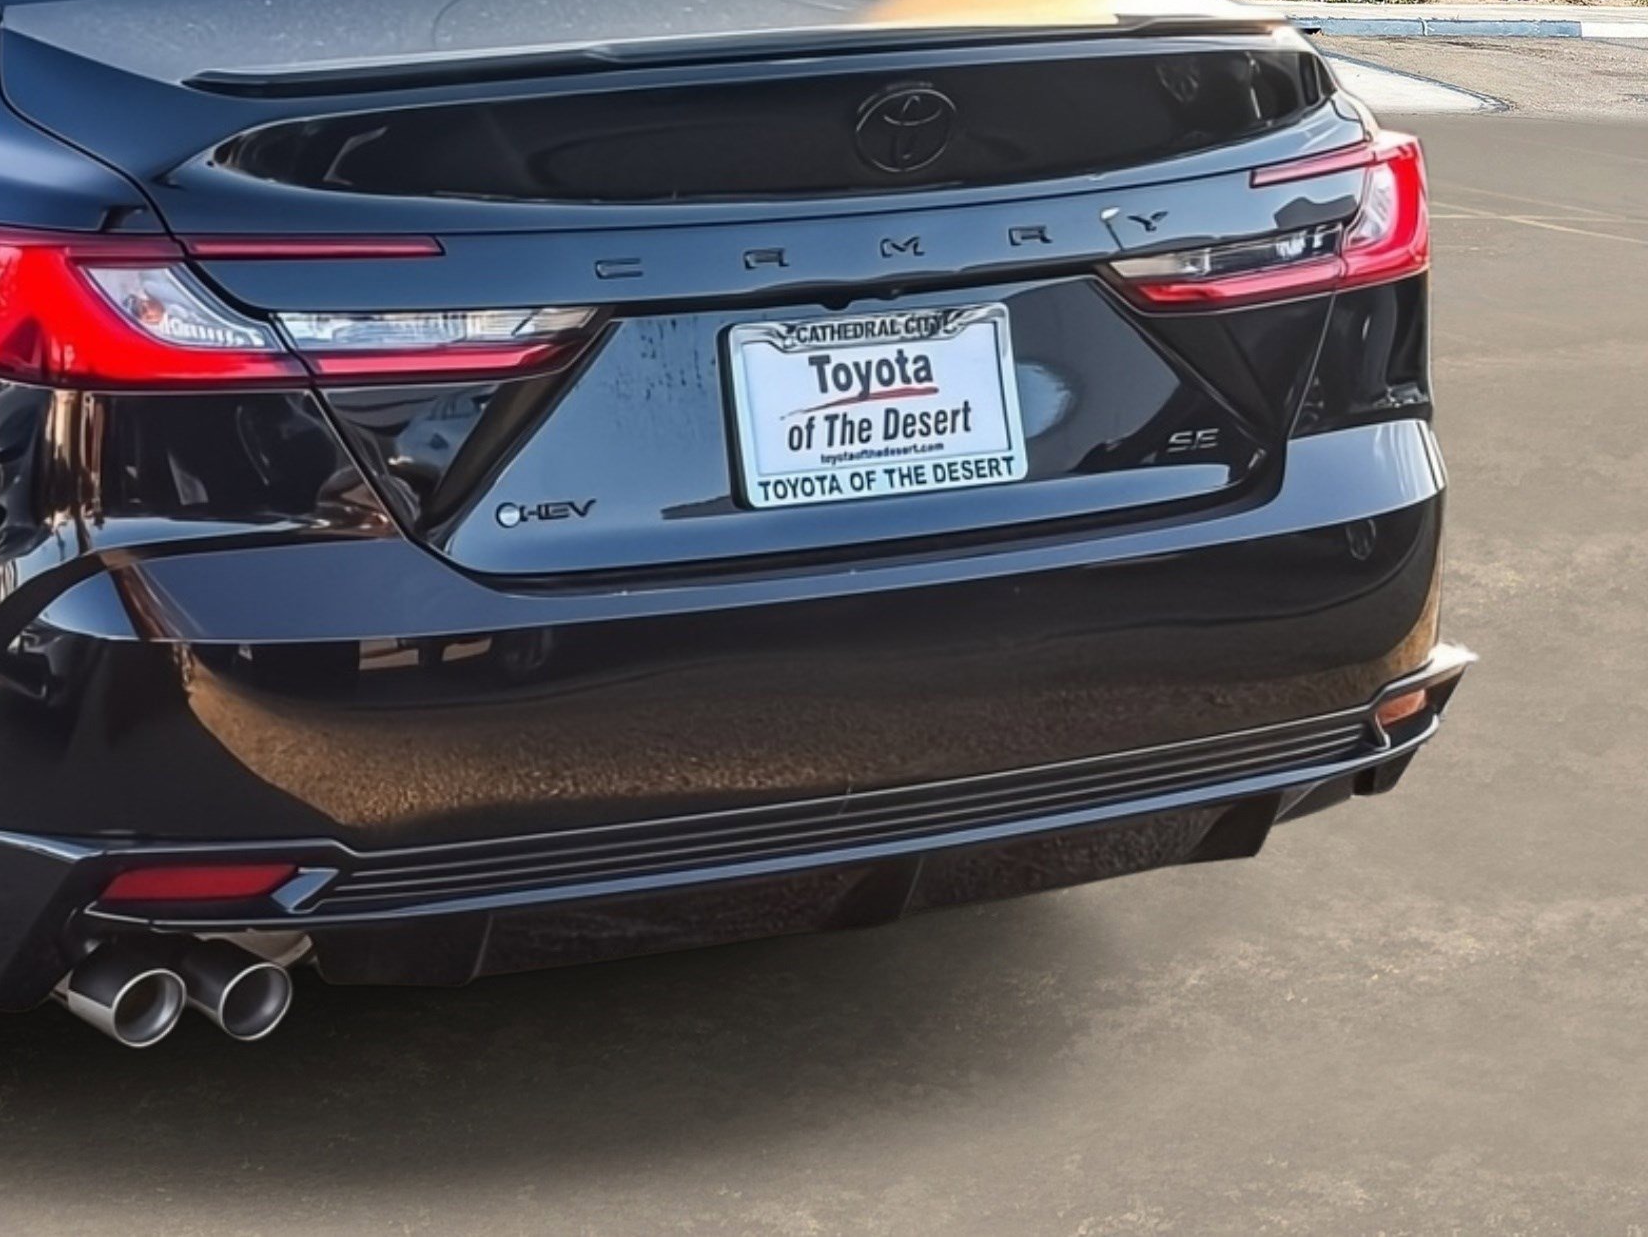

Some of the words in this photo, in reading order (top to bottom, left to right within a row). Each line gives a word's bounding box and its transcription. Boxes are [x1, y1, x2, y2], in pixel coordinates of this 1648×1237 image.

[595, 209, 1167, 280] CAMRY
[795, 318, 901, 343] CATHEDRAL
[808, 349, 934, 401] Toyota
[788, 416, 816, 452] of
[823, 412, 873, 449] The
[882, 400, 973, 442] Desert
[1166, 427, 1220, 454] SE
[758, 473, 844, 502] TOYOTA
[849, 470, 877, 492] OF
[883, 462, 928, 488] THE
[933, 456, 1016, 484] DESERT
